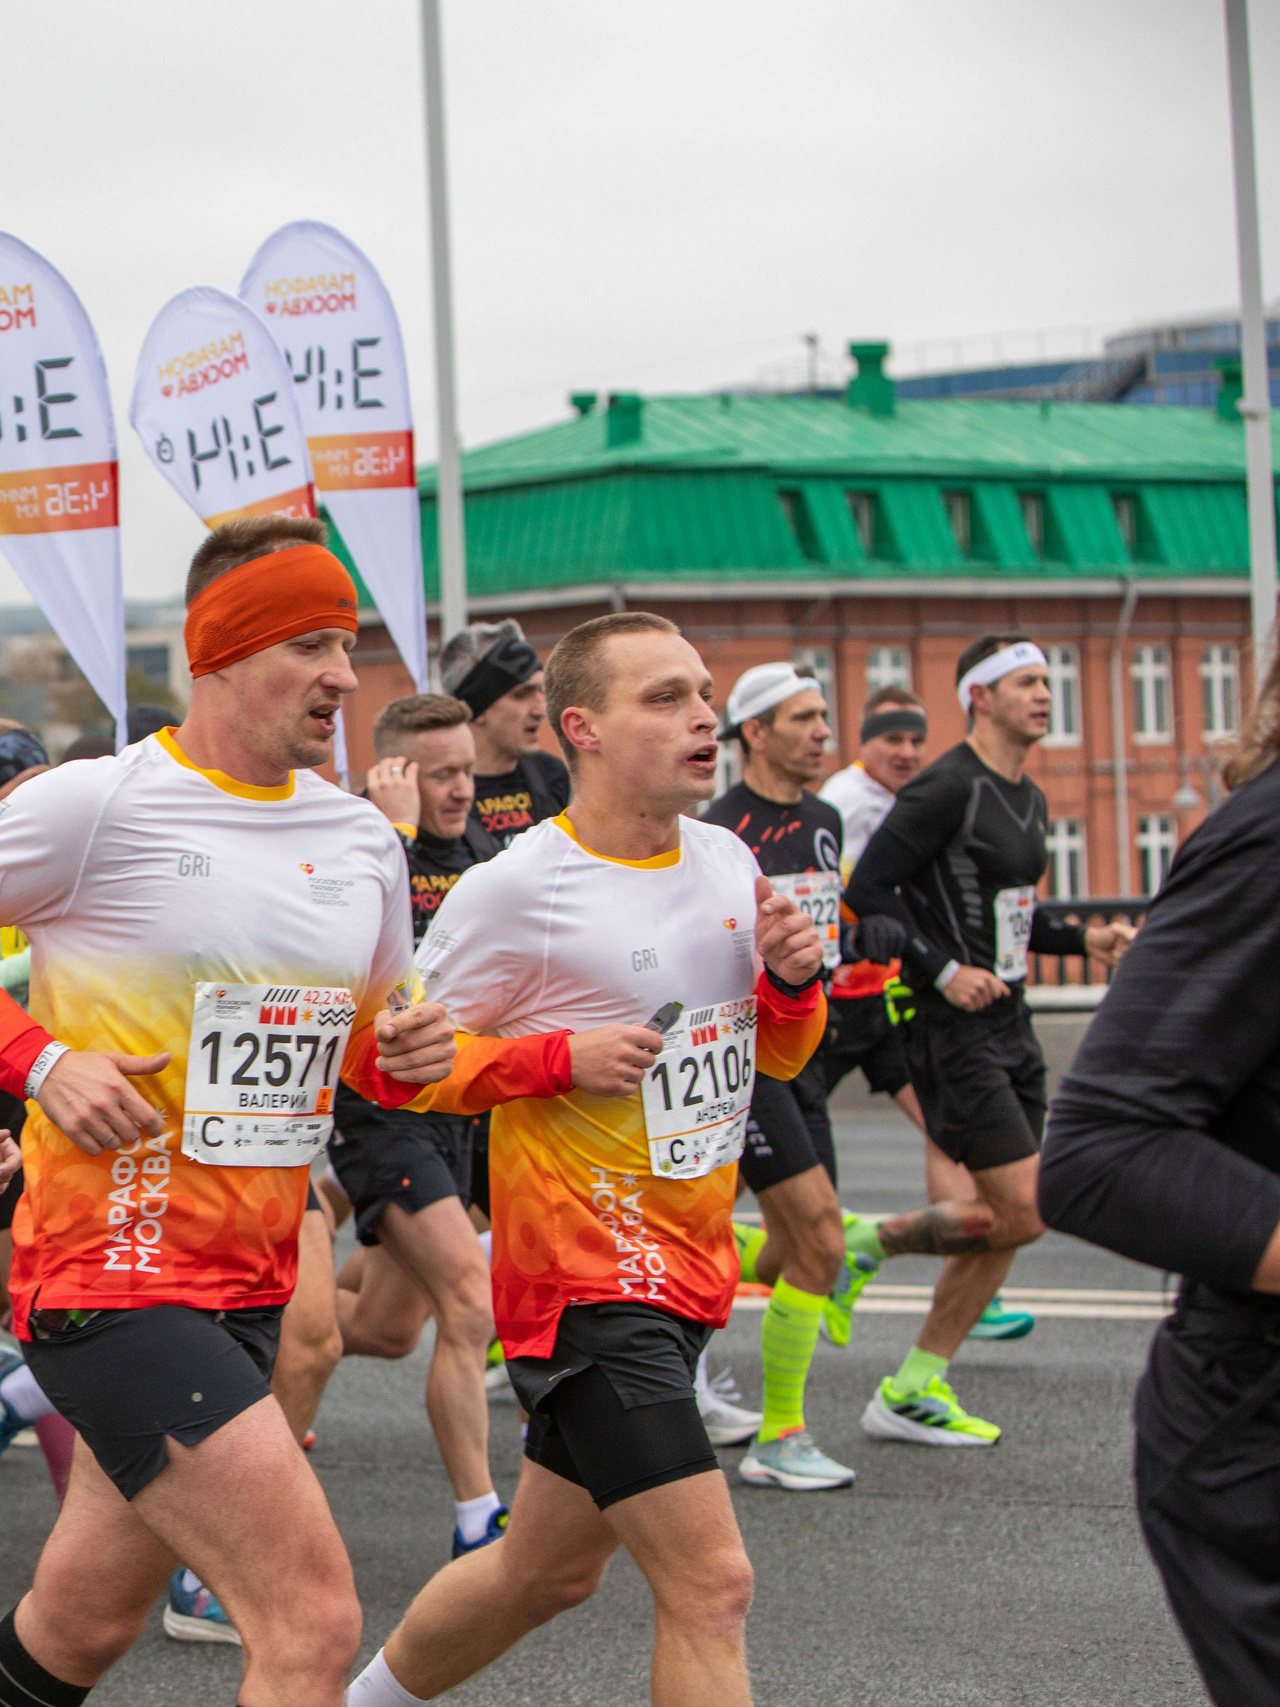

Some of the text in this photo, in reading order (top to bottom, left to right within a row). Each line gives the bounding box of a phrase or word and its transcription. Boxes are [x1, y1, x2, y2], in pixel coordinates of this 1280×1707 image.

[178, 854, 211, 877] GRi
[632, 948, 658, 972] GRi
[303, 990, 332, 1006] 42,2
[201, 1031, 340, 1088] 12571
[651, 1039, 751, 1111] 12106
[238, 1091, 309, 1108] ВАЛЕРИЙ
[695, 1097, 736, 1124] АНДРЕЙ
[133, 1131, 174, 1274] МОСКВА
